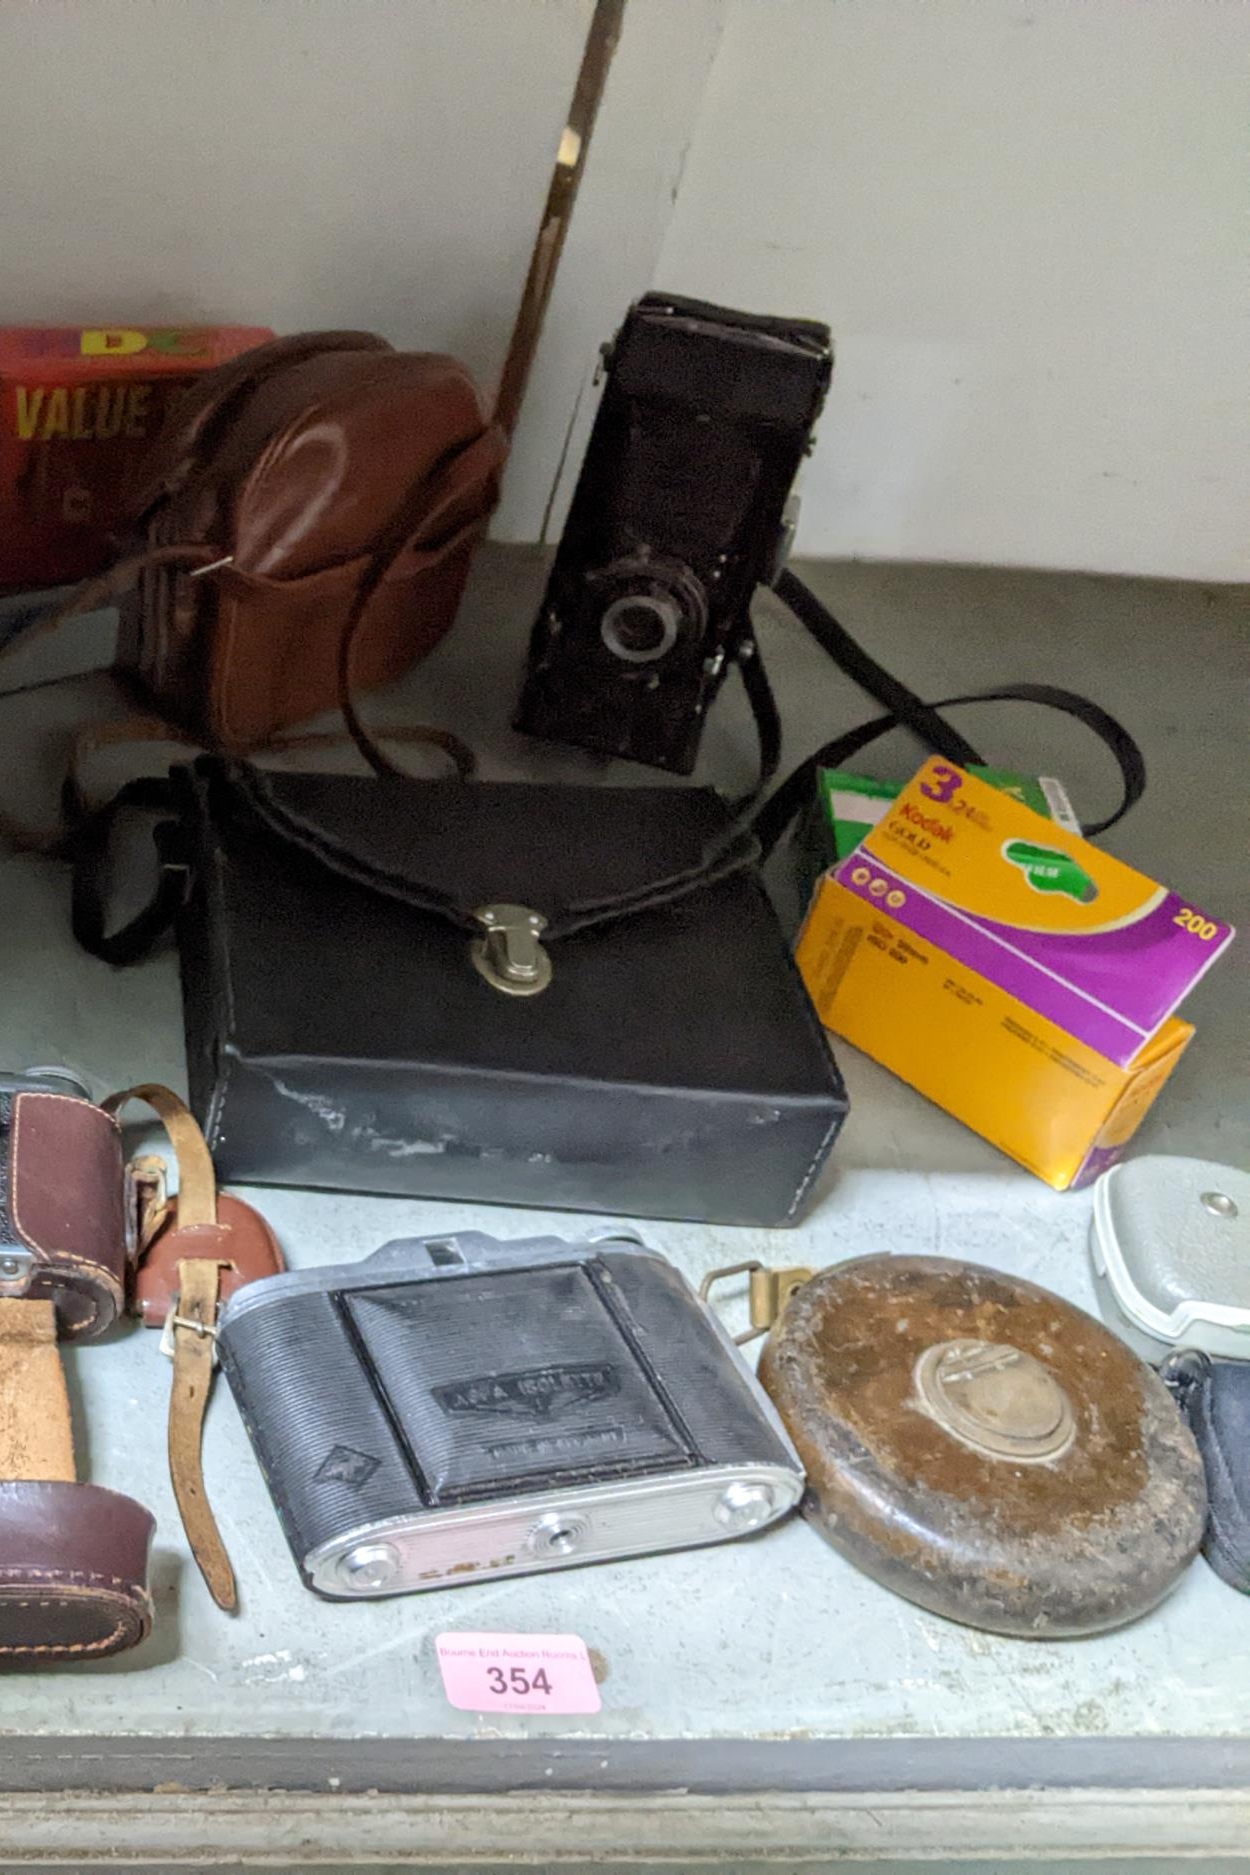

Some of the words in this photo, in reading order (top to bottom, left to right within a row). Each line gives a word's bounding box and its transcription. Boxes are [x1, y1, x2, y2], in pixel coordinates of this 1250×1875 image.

[15, 386, 151, 441] VALUE
[920, 766, 962, 803] 3
[899, 803, 954, 843] Kodak
[1172, 908, 1218, 941] 200
[478, 1648, 500, 1658] End
[487, 1667, 553, 1695] 354
